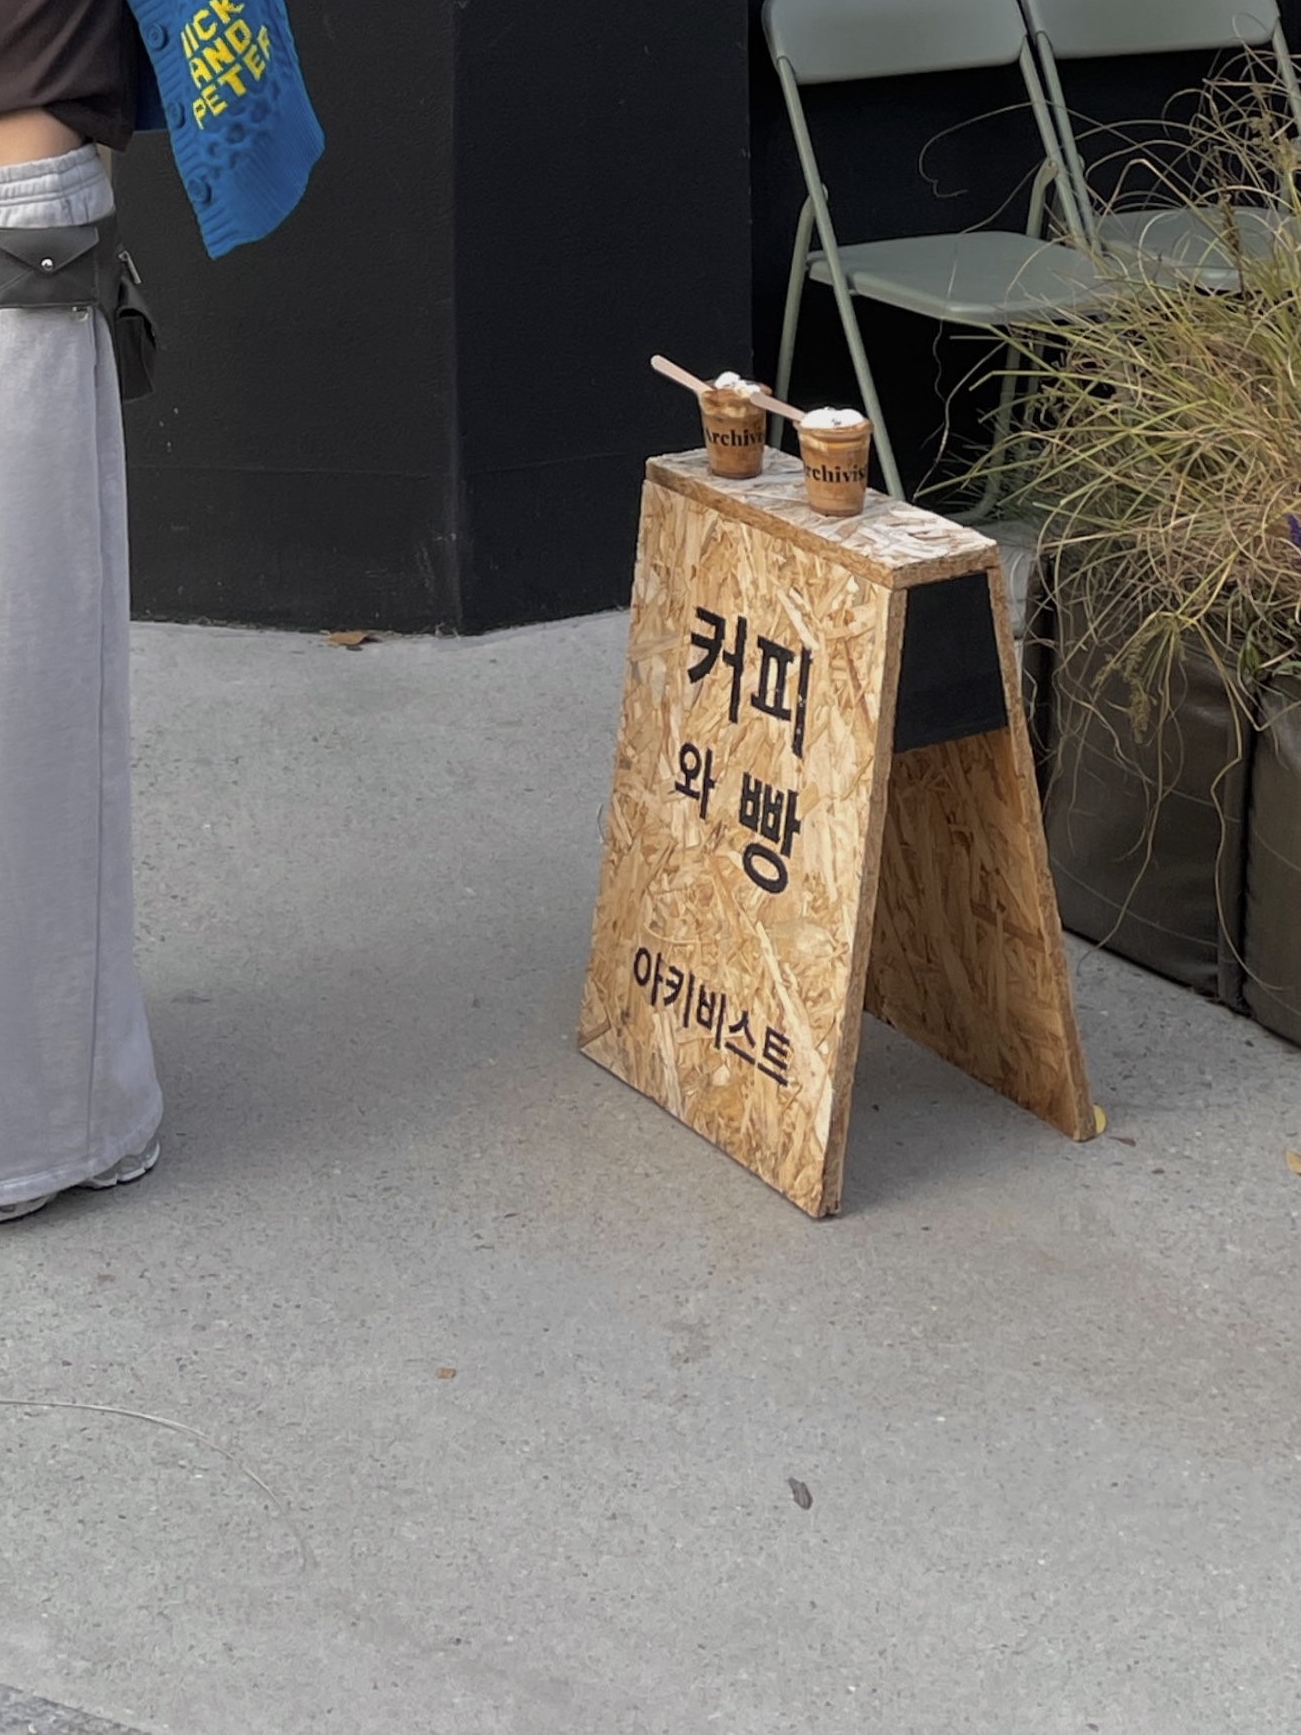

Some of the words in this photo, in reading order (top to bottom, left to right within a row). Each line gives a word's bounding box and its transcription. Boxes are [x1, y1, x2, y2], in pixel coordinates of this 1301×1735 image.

[188, 19, 252, 89] AND
[687, 606, 813, 759] 커피
[675, 741, 716, 820] 와
[738, 771, 802, 895] 빵
[633, 947, 791, 1087] 아키비스트
